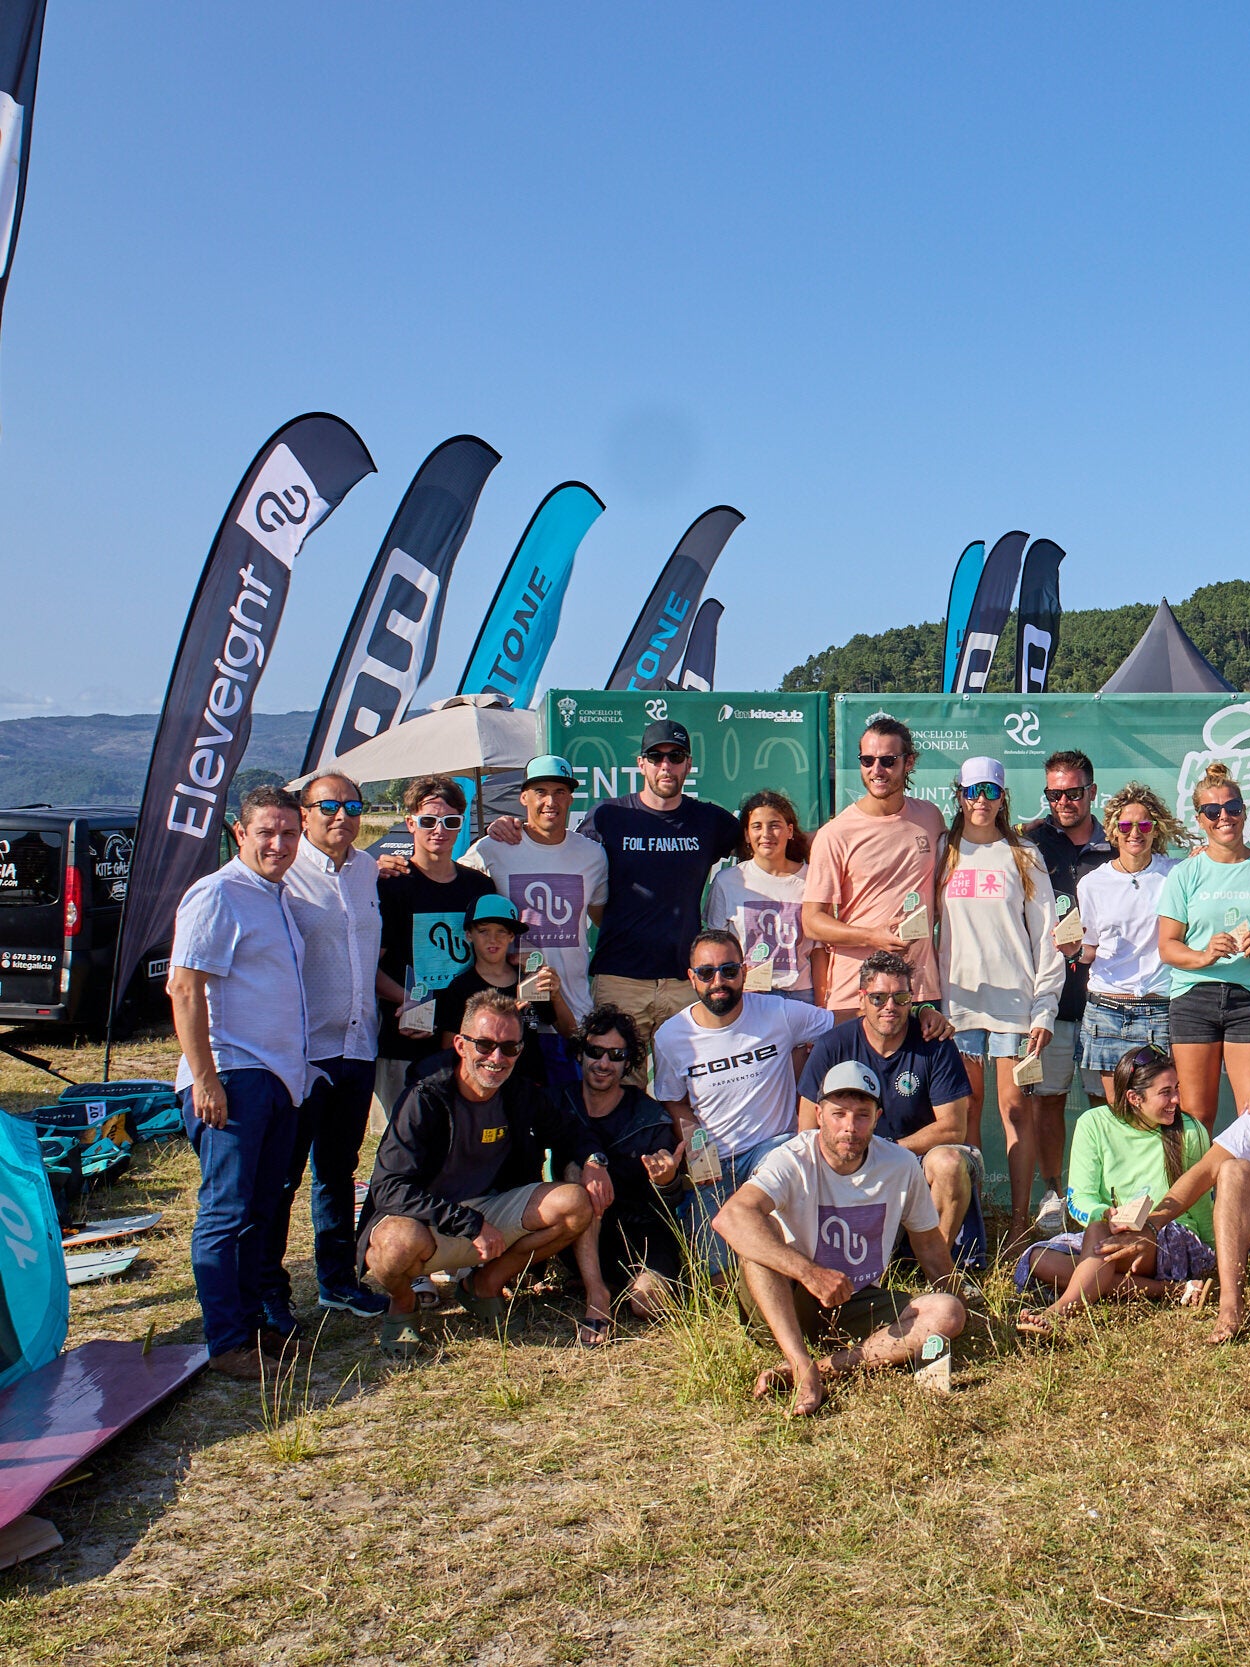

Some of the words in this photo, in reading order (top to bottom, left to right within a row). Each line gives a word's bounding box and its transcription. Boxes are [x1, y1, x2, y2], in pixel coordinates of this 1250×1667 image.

[480, 565, 552, 694] TONE
[167, 563, 273, 839] Eleveight
[911, 731, 953, 739] ONCELLO
[955, 731, 968, 739] DE
[623, 836, 646, 851] FOIL
[648, 836, 700, 851] FANATICS
[951, 880, 971, 888] CHE
[12, 953, 26, 961] 678
[27, 954, 42, 962] 359
